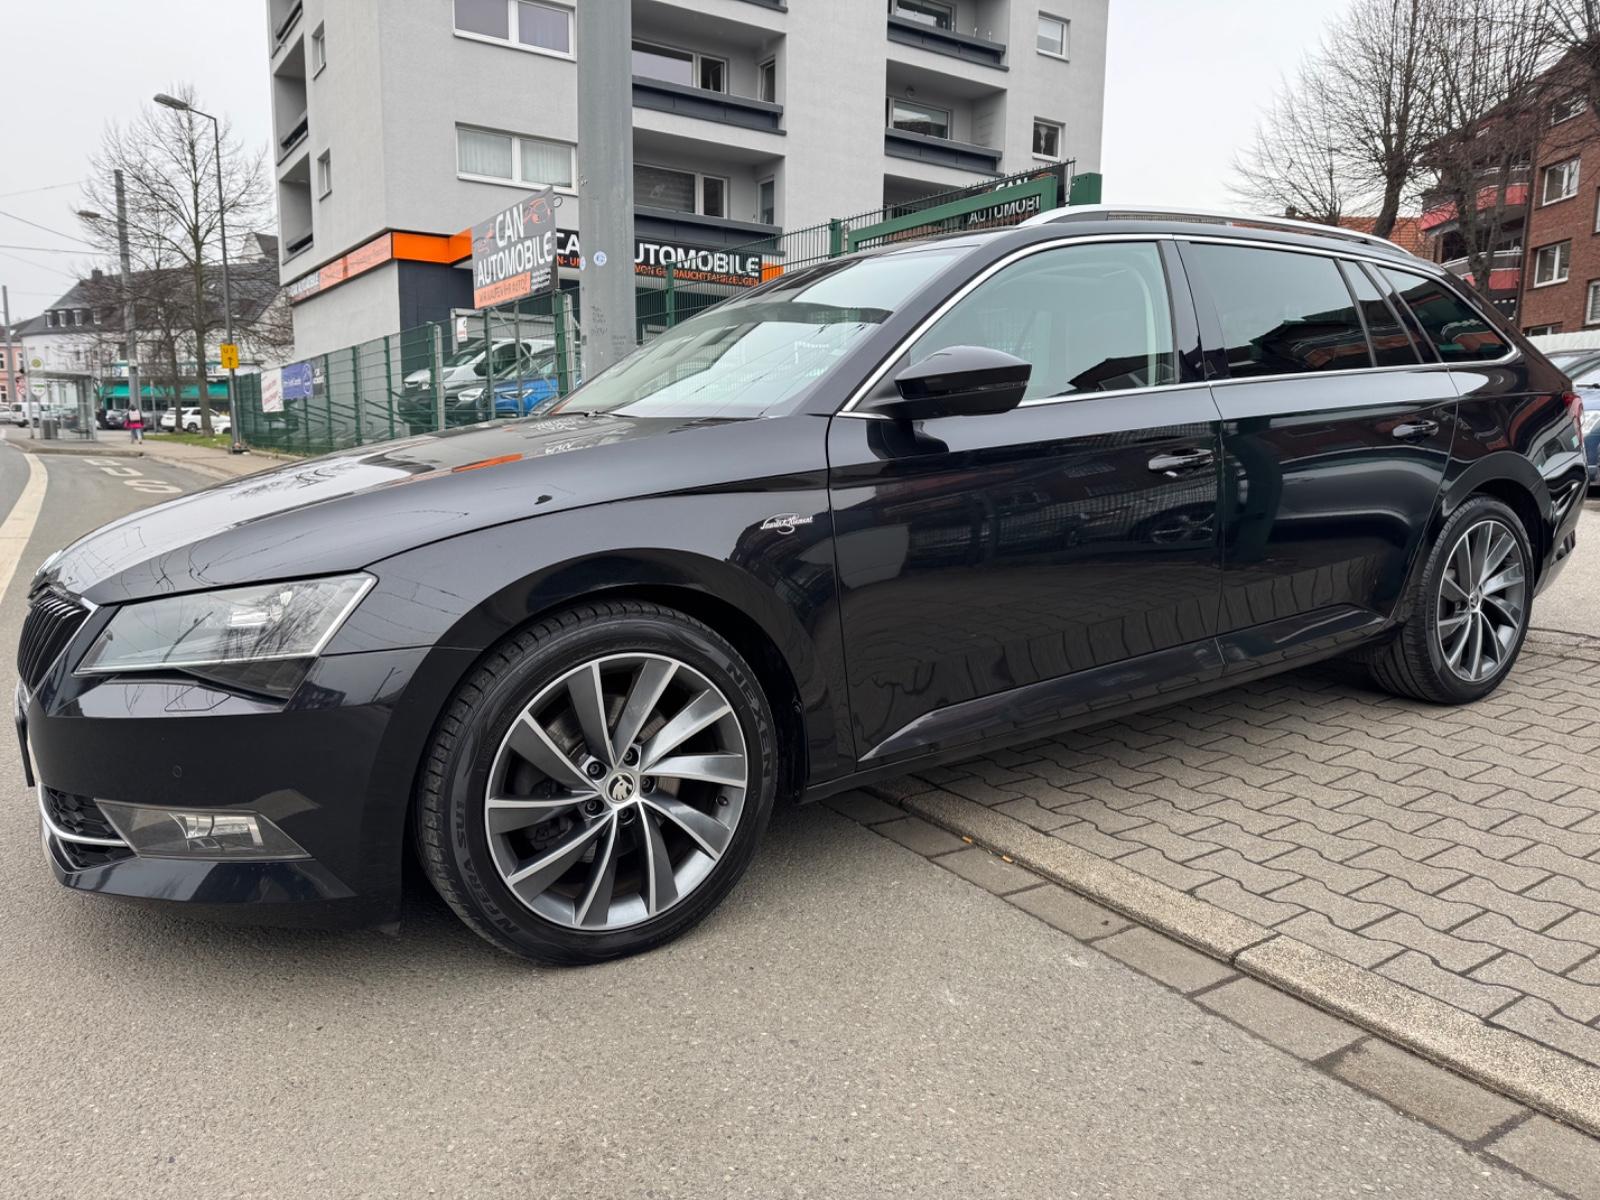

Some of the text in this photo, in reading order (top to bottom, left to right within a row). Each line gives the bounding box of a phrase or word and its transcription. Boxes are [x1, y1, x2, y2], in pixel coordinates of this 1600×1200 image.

[495, 203, 524, 248] CAN
[477, 230, 553, 287] AUTOMOBILE
[725, 661, 772, 780] NEXEN
